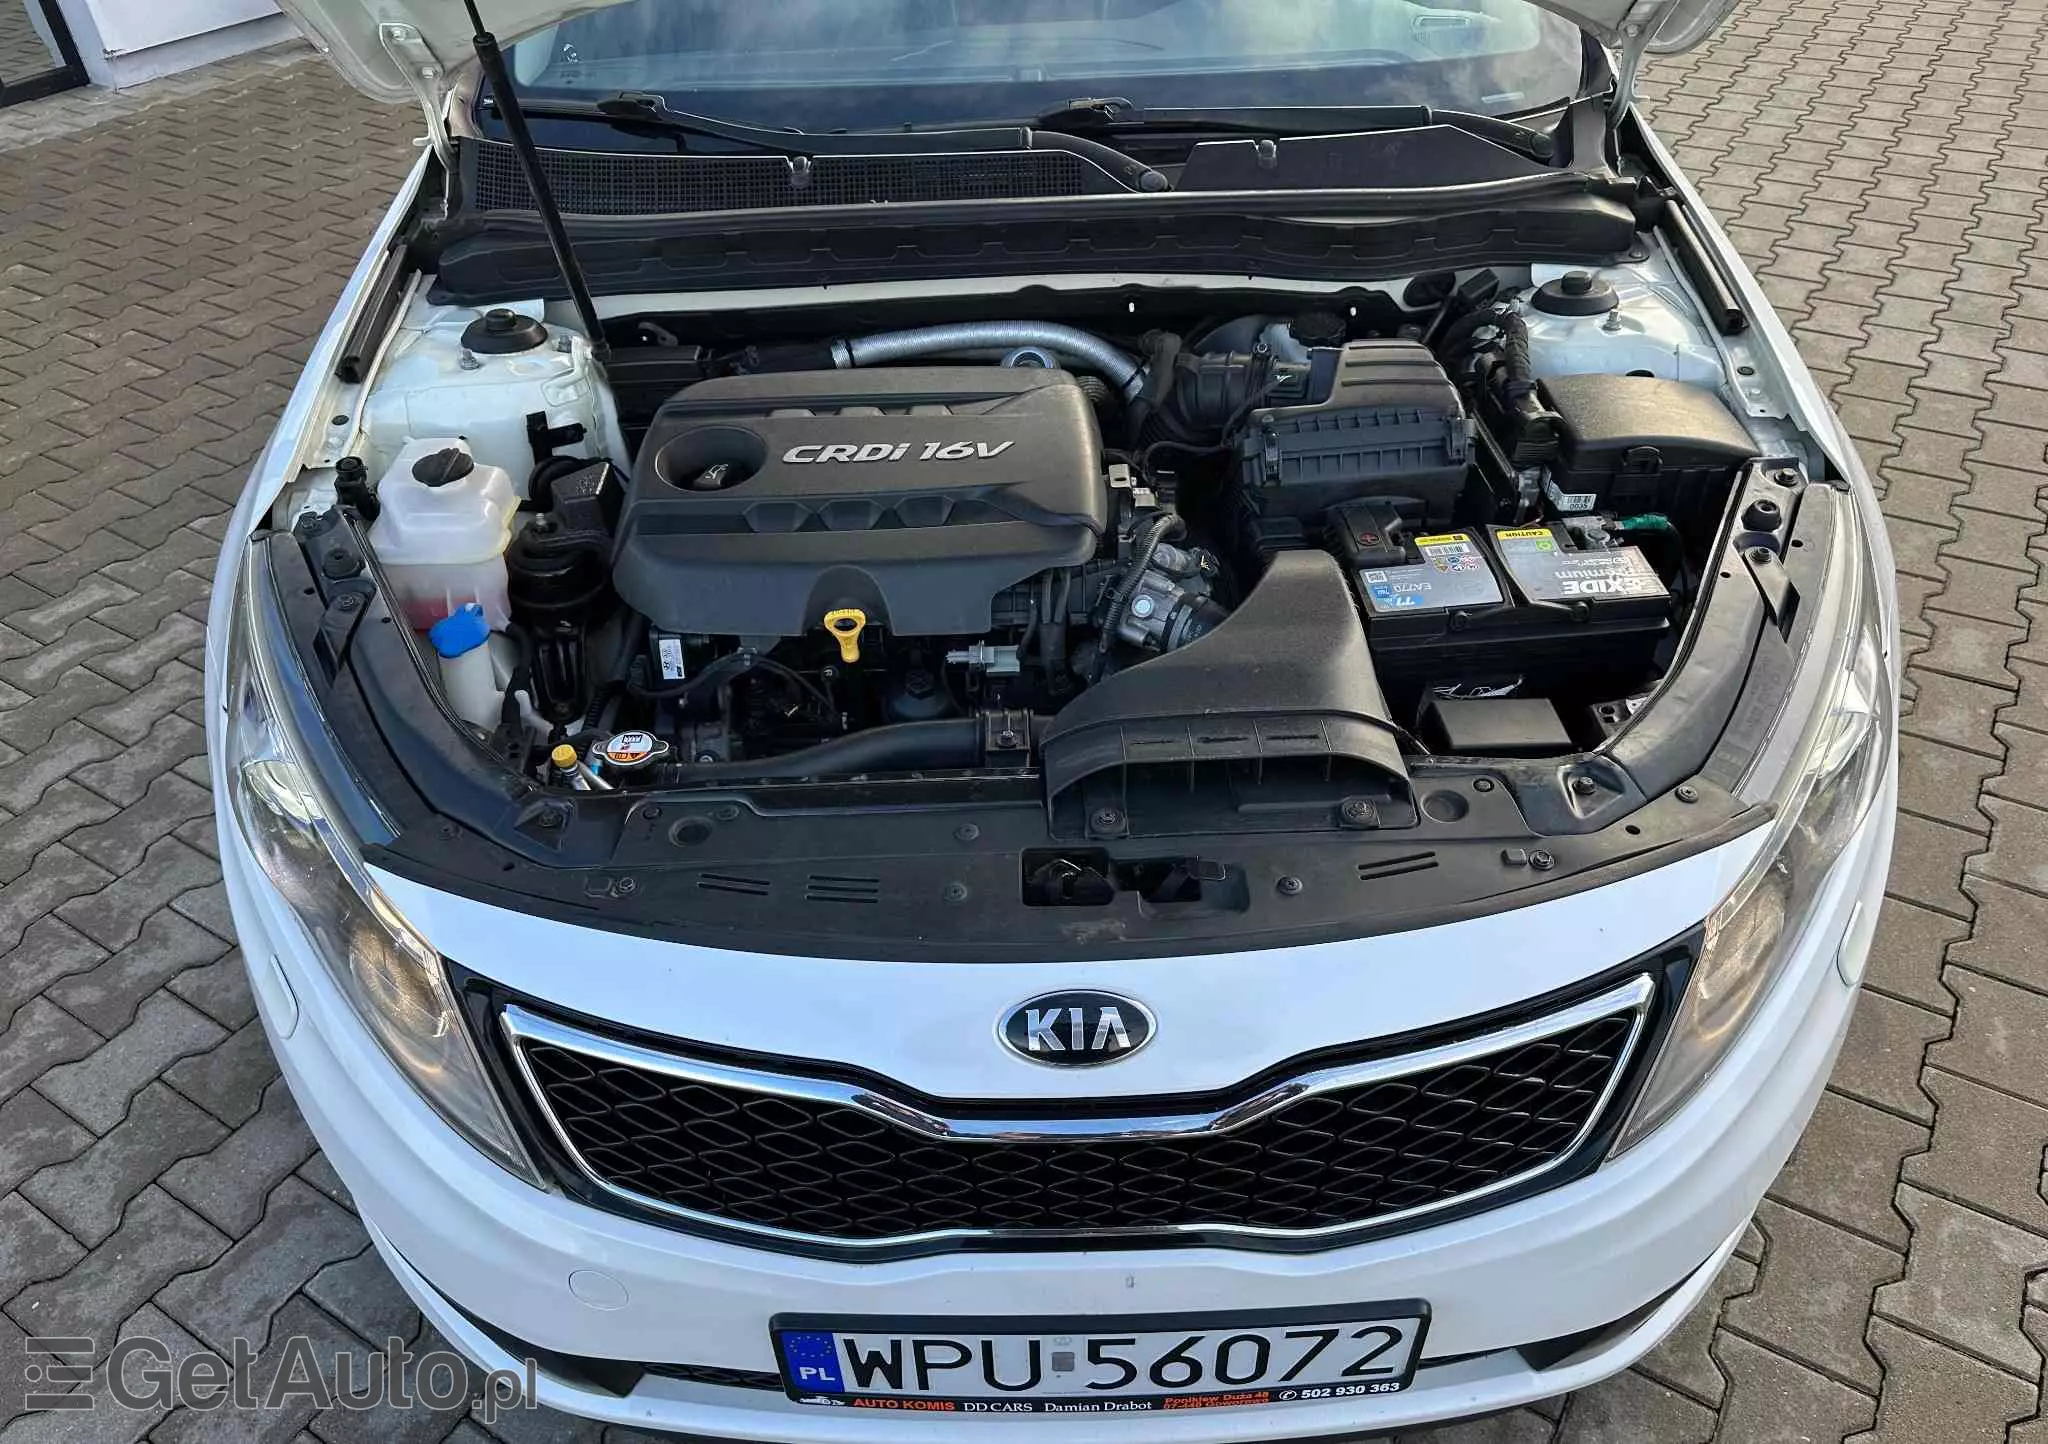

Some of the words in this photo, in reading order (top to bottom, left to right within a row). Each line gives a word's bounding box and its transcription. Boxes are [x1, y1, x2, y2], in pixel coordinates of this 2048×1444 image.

[783, 442, 912, 464] CRDi
[919, 440, 1015, 461] 16V
[1562, 576, 1638, 596] EXIDE
[1025, 1006, 1132, 1051] KIA
[843, 1338, 1042, 1391] WPU
[1085, 1325, 1402, 1391] 56072
[799, 1365, 837, 1382] PL
[1301, 1388, 1331, 1399] 502
[1335, 1385, 1366, 1396] 930
[1369, 1382, 1400, 1393] 363
[853, 1397, 899, 1408] AUTO
[903, 1399, 956, 1411] KOMIS
[963, 1402, 988, 1412] DD
[990, 1402, 1033, 1412] CARS
[1045, 1402, 1100, 1412] Damian
[1104, 1401, 1153, 1411] Drabot
